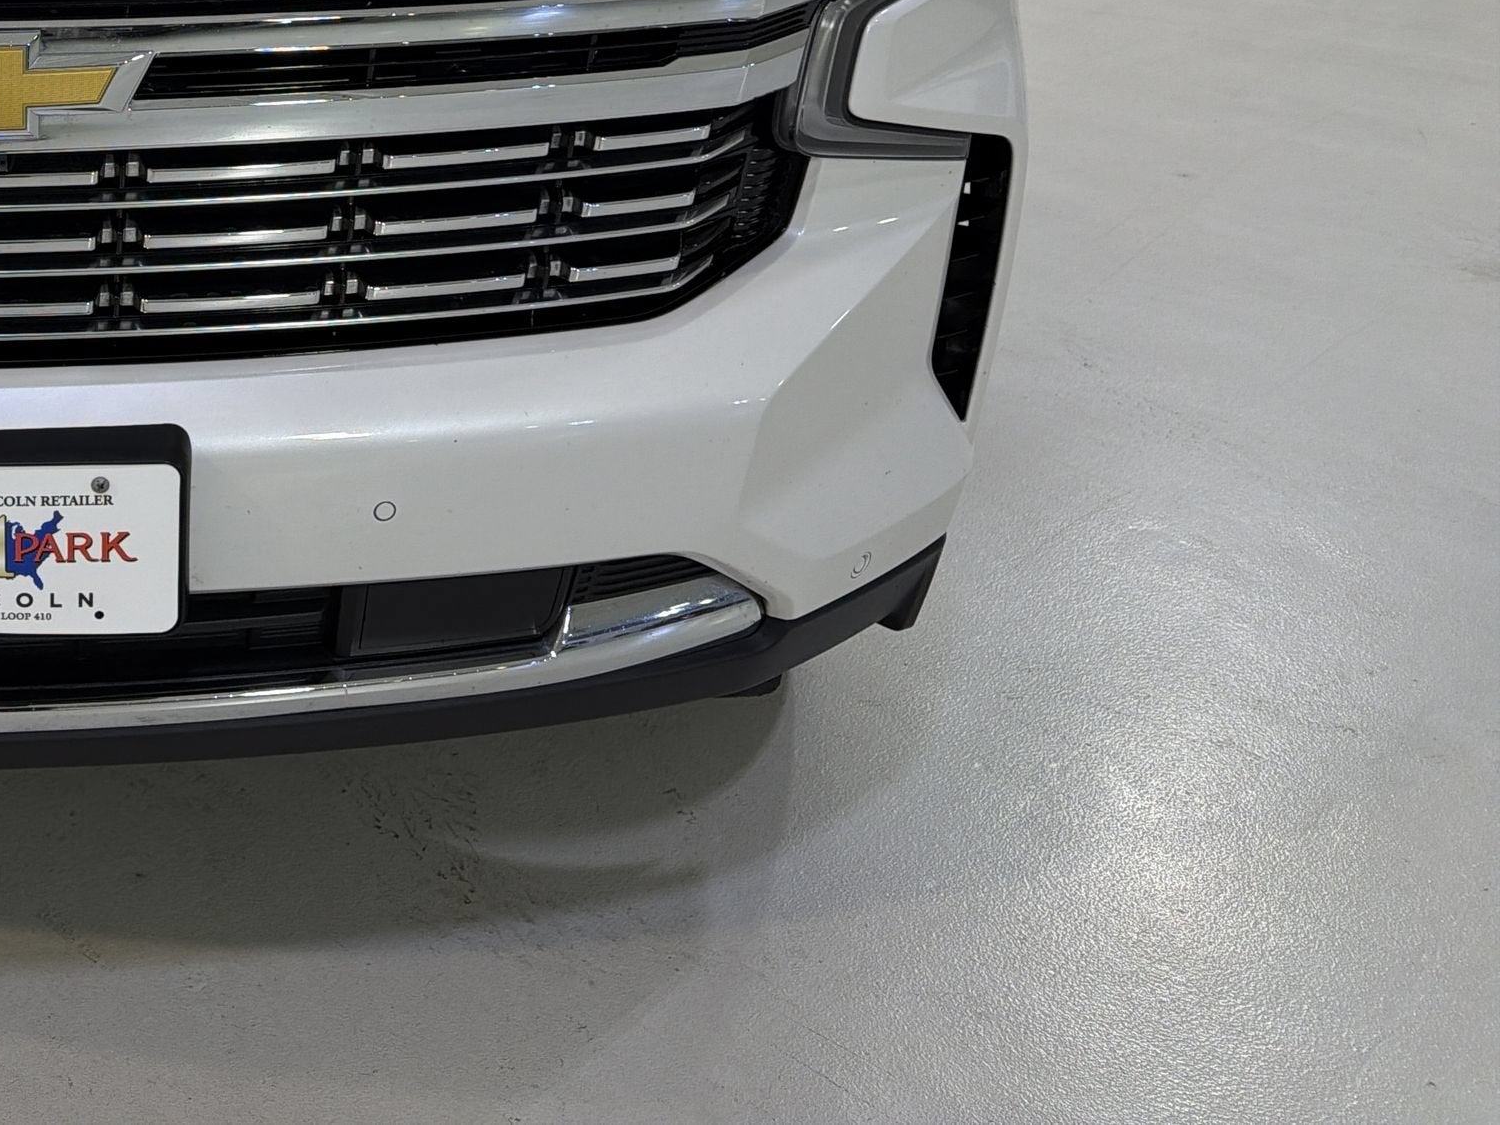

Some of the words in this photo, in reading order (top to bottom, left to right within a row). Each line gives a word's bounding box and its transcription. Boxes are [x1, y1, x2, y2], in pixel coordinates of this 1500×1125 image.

[41, 494, 114, 507] RETAILER
[13, 531, 139, 563] PARK
[1, 611, 31, 621] LOOP
[33, 611, 53, 622] 410
